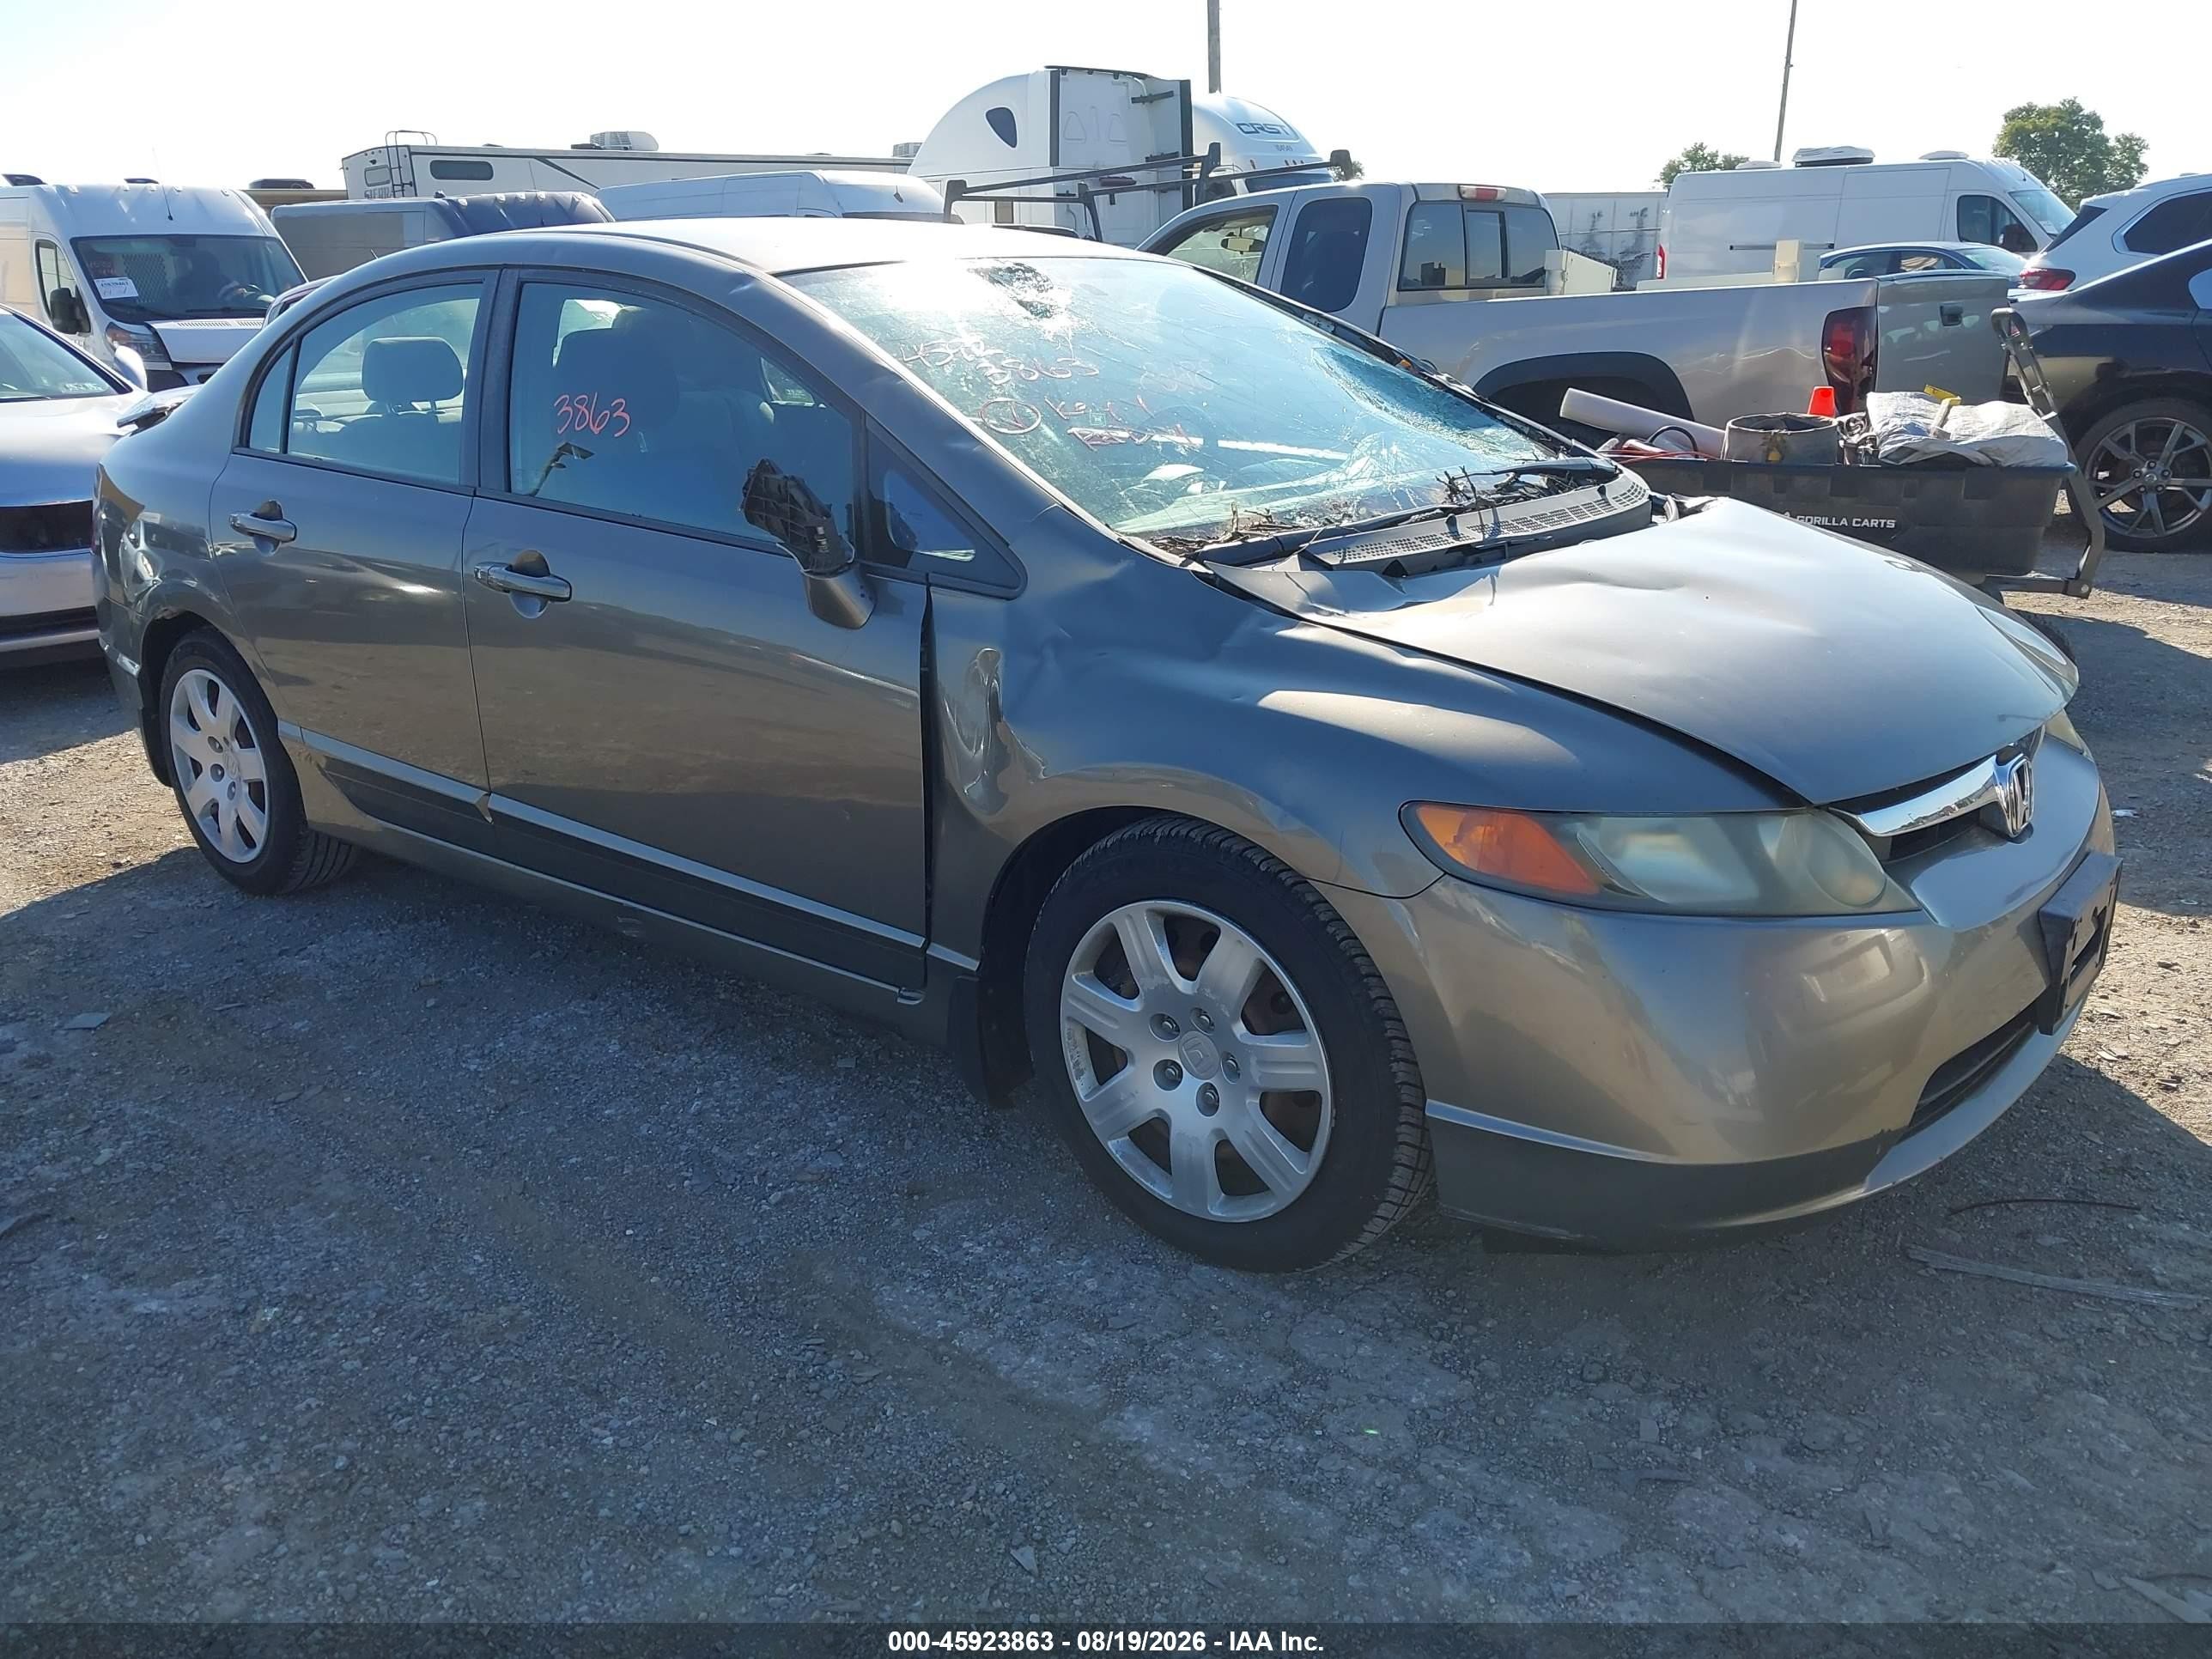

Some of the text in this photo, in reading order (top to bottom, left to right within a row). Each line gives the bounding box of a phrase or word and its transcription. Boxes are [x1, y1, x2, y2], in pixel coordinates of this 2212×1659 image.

[1236, 122, 1291, 136] CRST
[975, 356, 1100, 386] 3863
[553, 392, 631, 438] 3863
[1796, 515, 1896, 528] GORILLA CARTS
